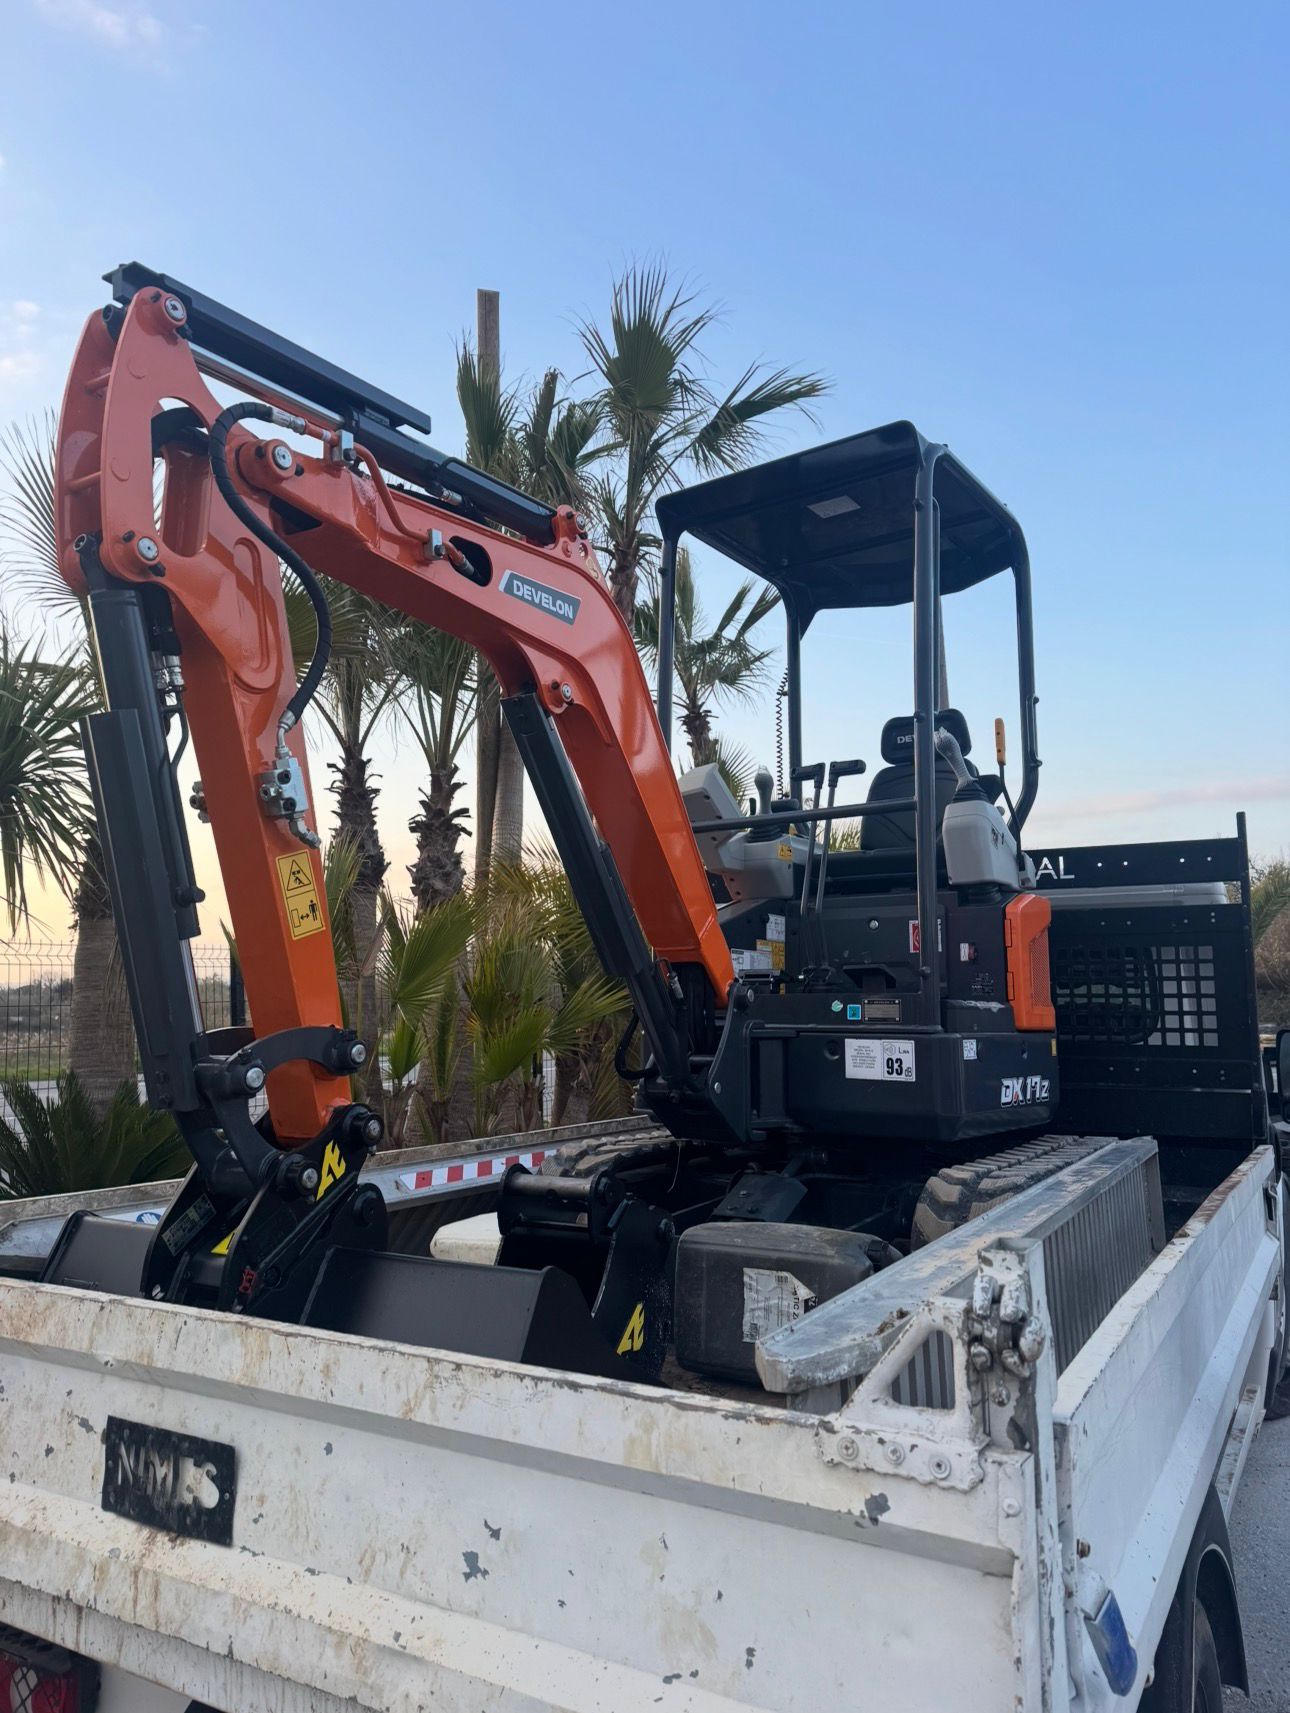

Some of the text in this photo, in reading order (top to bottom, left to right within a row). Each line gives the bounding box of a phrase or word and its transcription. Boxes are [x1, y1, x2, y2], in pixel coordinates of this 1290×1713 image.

[512, 579, 574, 619] DEVELON
[886, 1057, 903, 1076] 93
[904, 1067, 913, 1078] dB
